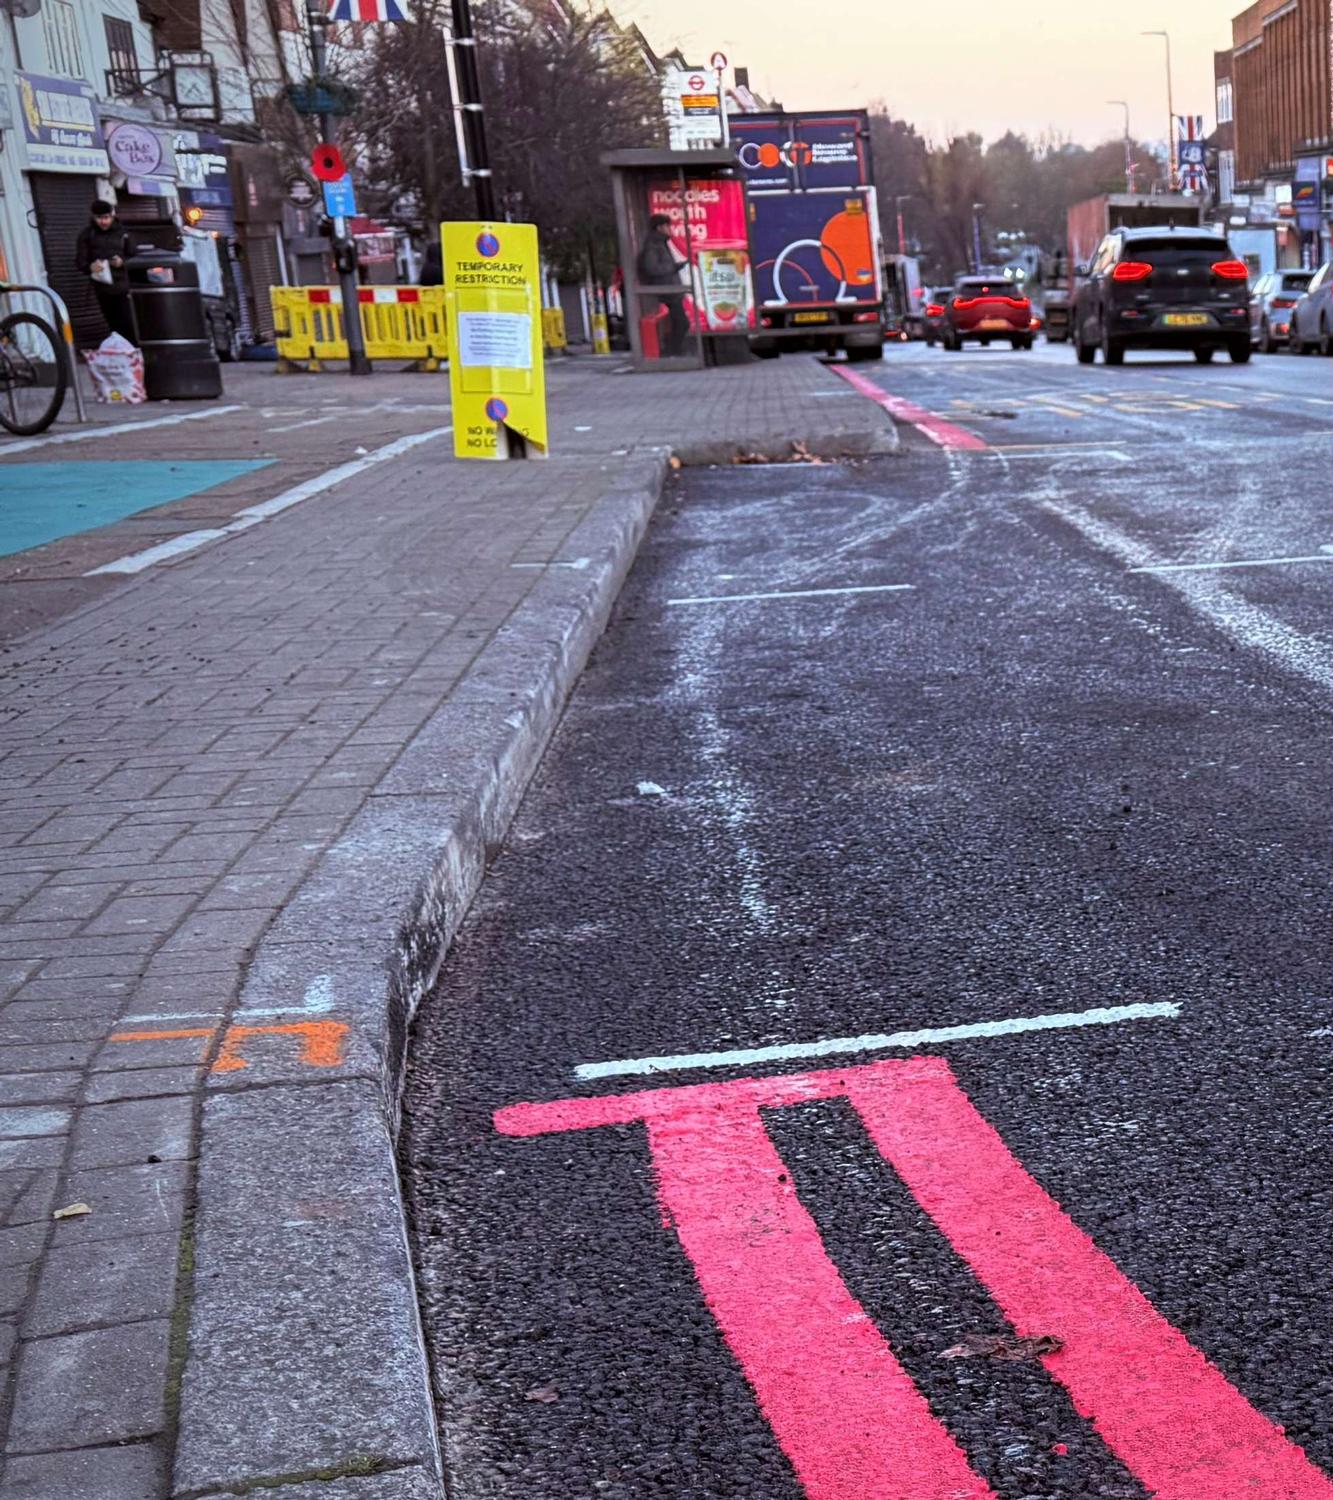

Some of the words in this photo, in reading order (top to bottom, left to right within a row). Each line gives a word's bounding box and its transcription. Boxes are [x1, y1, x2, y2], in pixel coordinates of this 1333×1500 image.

[115, 140, 151, 153] Cake
[456, 261, 523, 273] TEMPORARY
[455, 273, 527, 285] RESTRICTION
[467, 426, 483, 435] NO
[467, 438, 482, 448] NO
